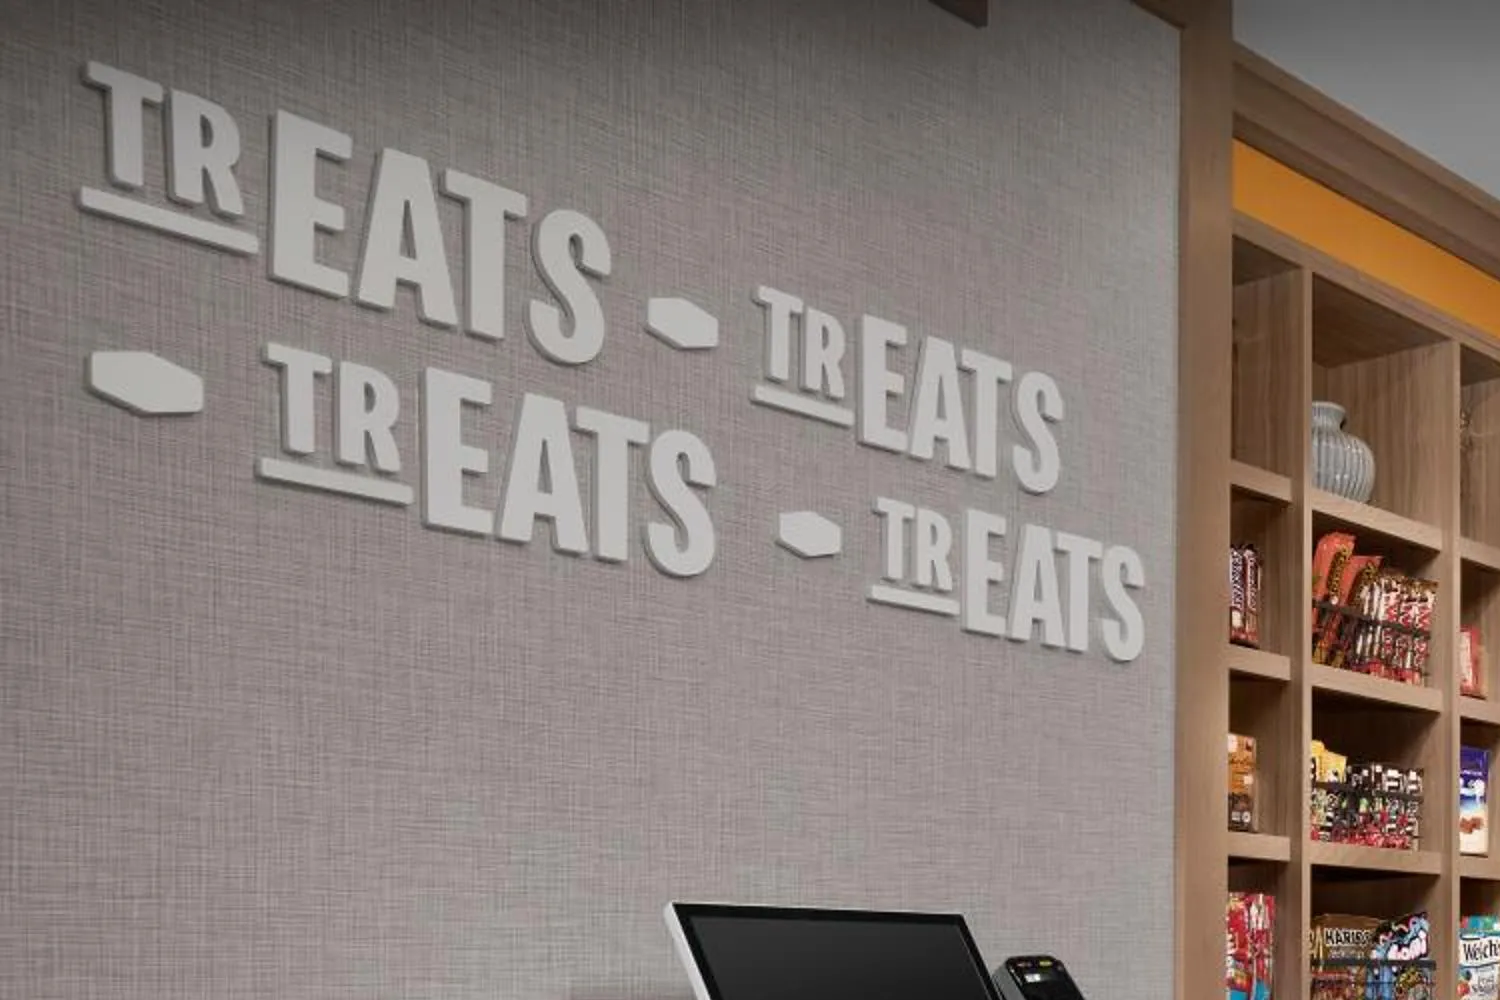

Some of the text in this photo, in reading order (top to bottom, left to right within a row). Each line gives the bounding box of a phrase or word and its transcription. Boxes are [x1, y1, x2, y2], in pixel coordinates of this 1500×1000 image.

[80, 60, 613, 366] TREATS
[260, 342, 718, 578] TREATS
[755, 286, 1065, 494] TREATS
[870, 497, 1147, 662] TREATS
